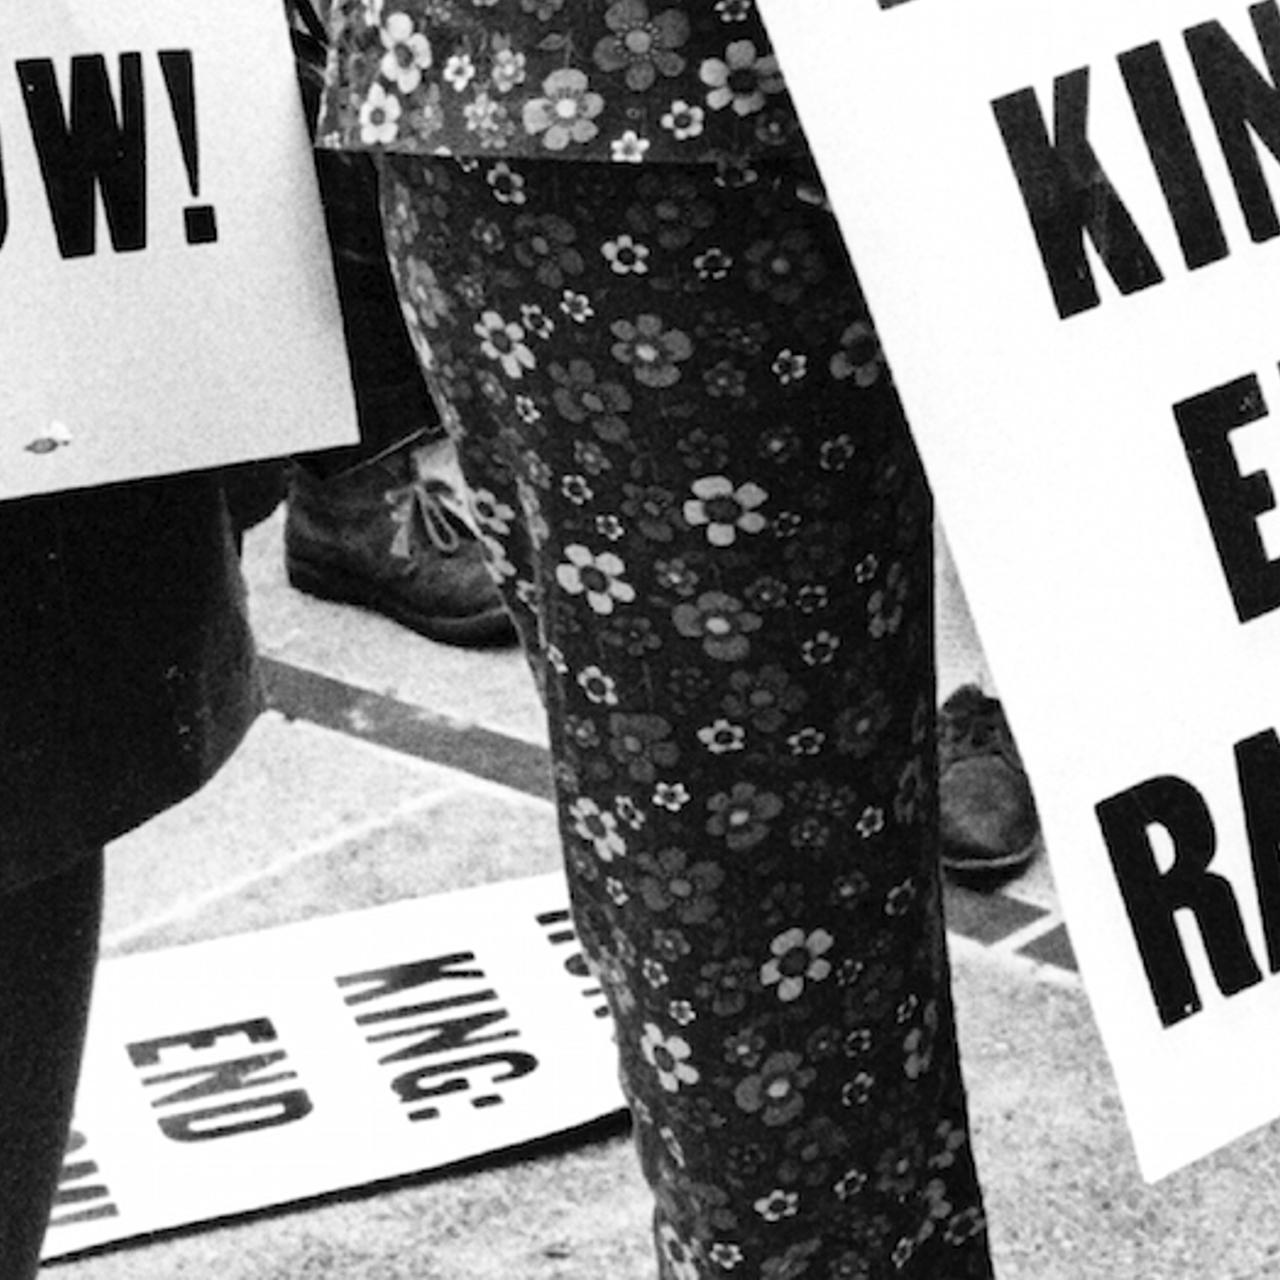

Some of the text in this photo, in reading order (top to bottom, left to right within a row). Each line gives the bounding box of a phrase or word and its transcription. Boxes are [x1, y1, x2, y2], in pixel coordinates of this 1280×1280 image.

[0, 49, 218, 260] W!
[127, 1017, 313, 1142] END
[336, 951, 539, 1122] KING:
